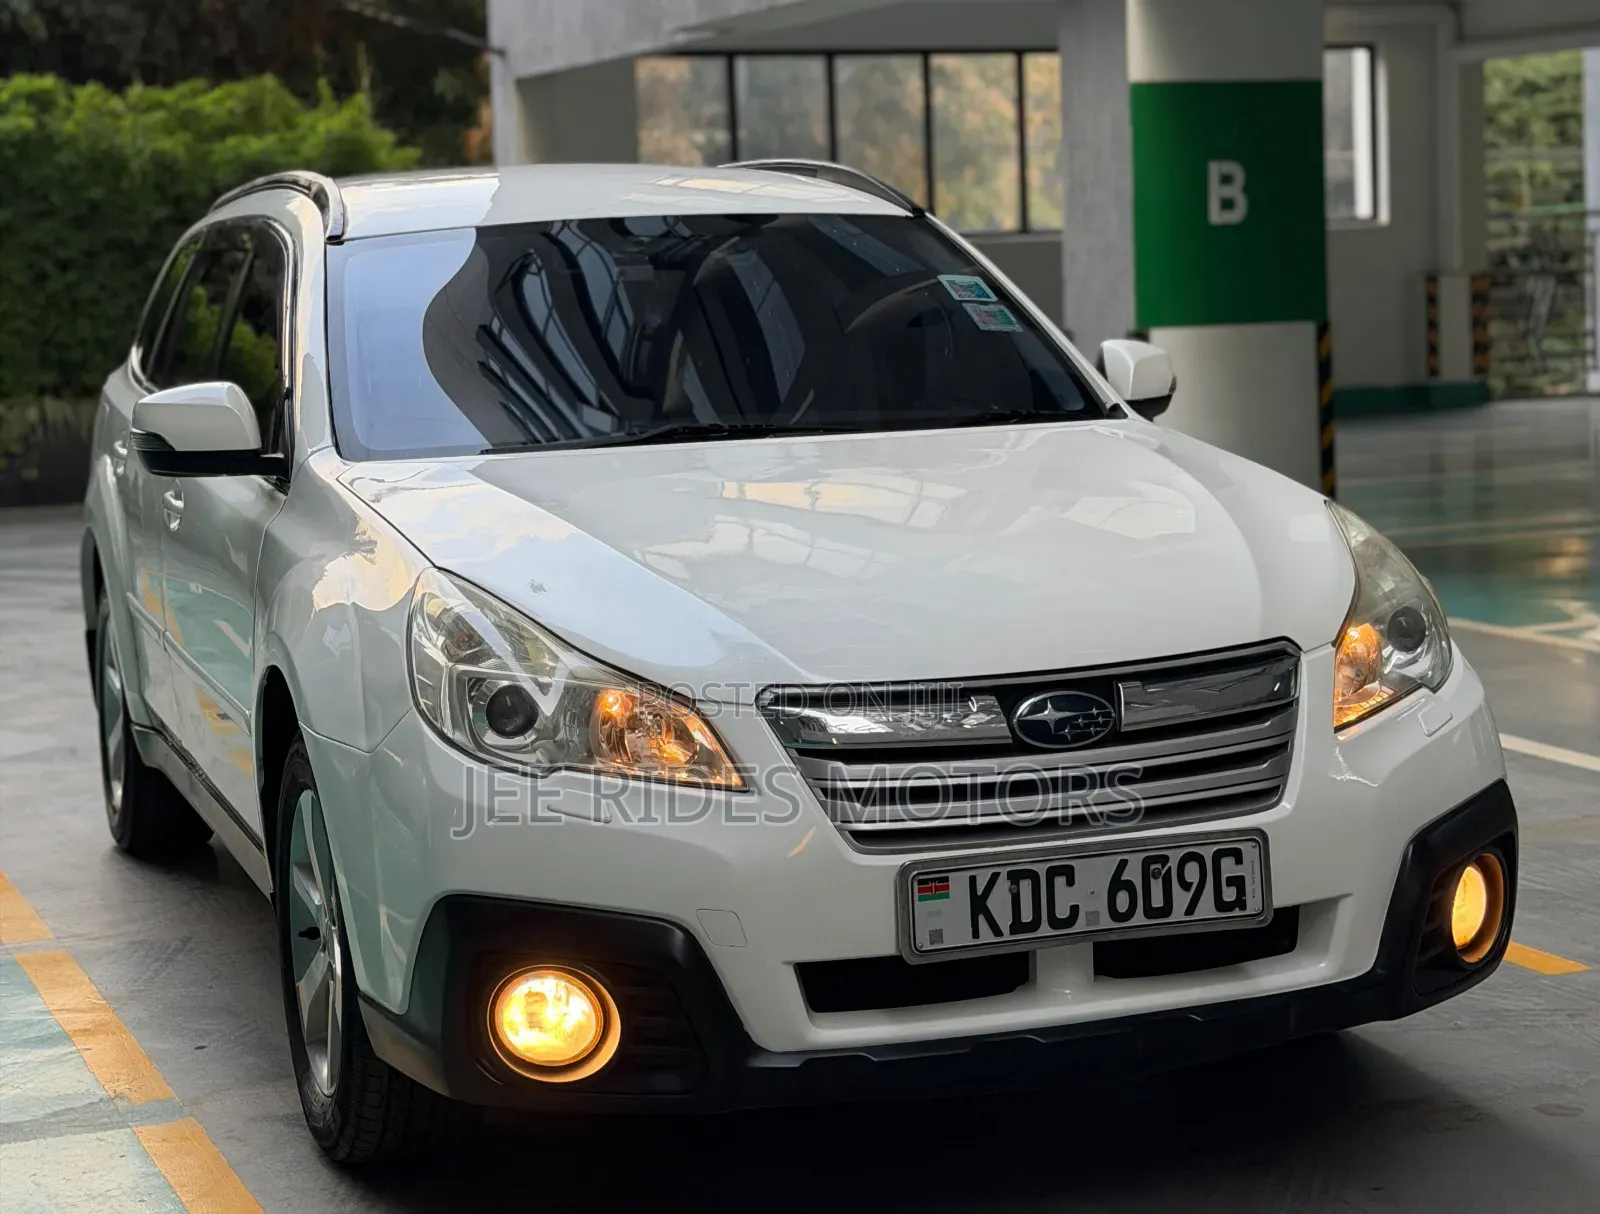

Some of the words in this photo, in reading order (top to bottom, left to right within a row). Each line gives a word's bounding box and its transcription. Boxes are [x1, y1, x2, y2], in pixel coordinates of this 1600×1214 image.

[1207, 160, 1248, 226] B
[968, 863, 1080, 940] KDC
[1107, 847, 1247, 923] 609G
